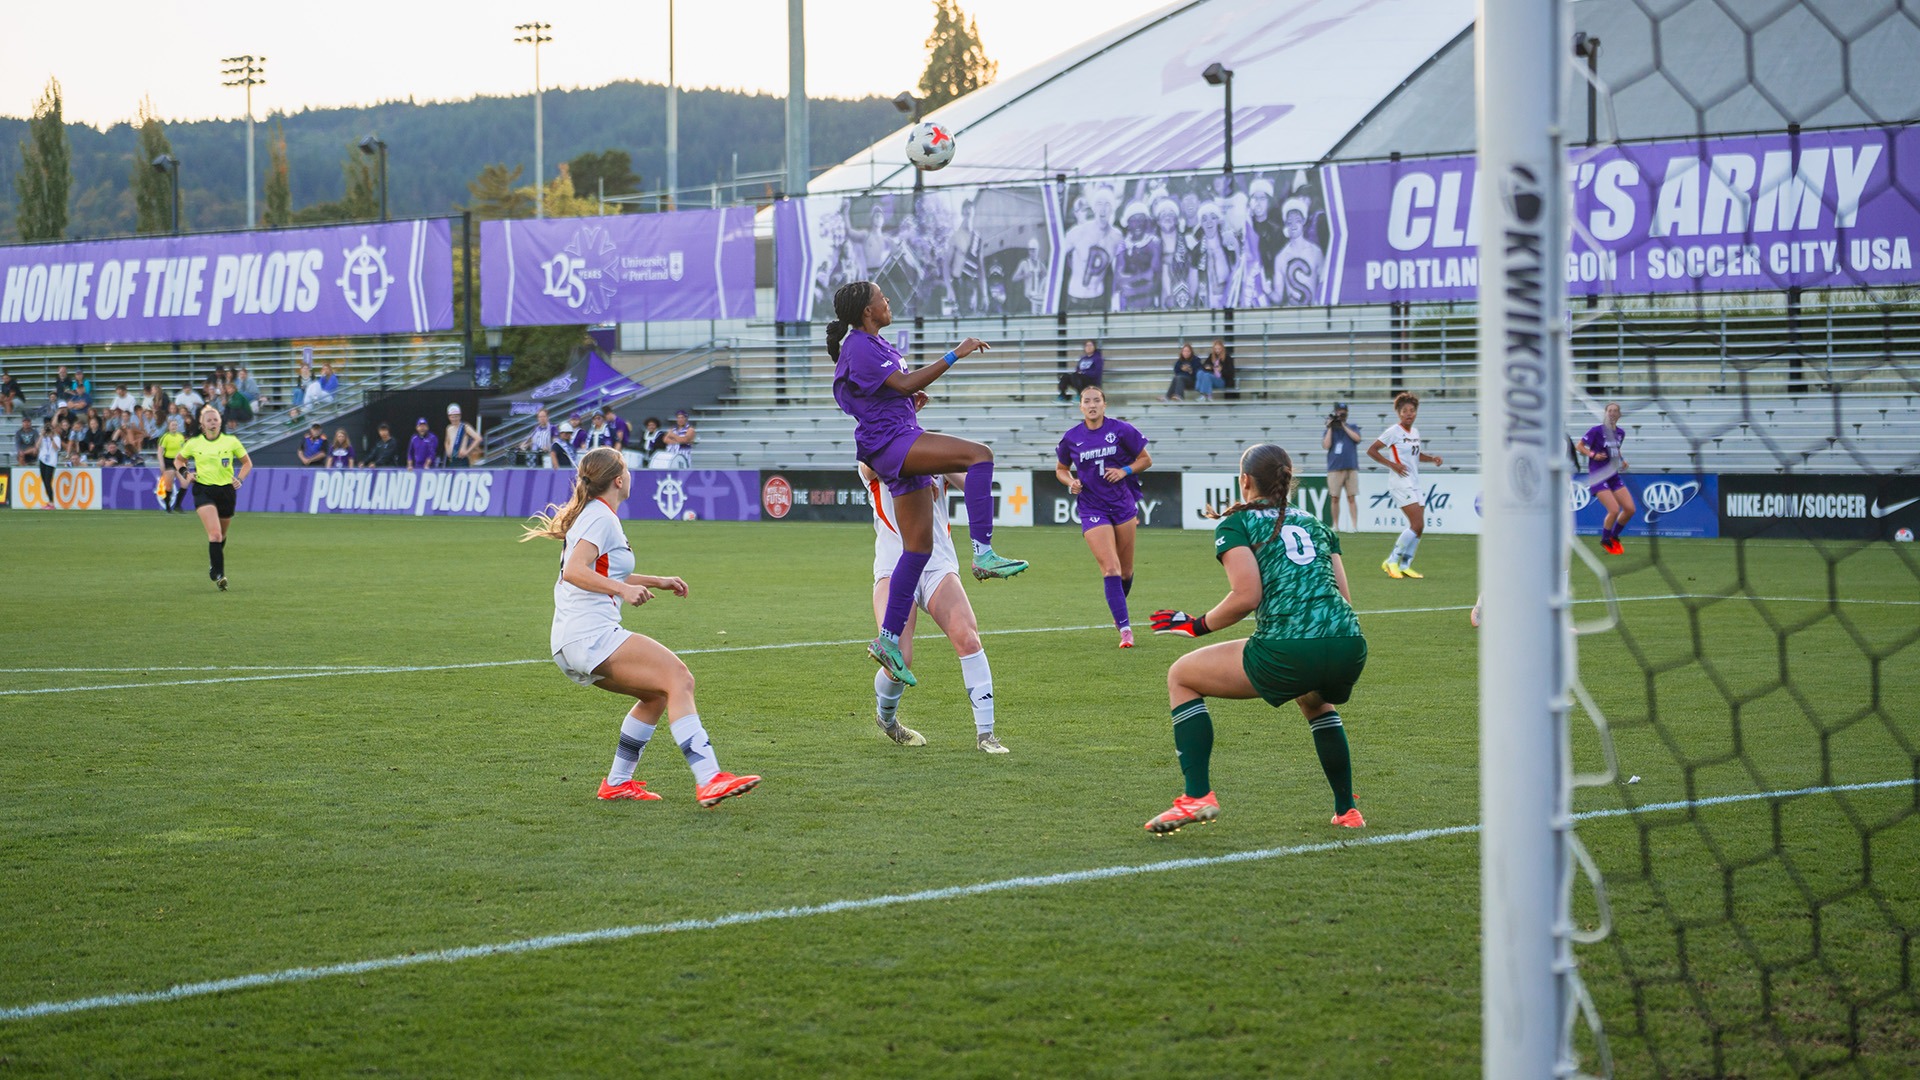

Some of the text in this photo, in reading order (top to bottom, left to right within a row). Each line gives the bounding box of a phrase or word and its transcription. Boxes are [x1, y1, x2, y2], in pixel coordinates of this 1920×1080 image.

[1387, 144, 1883, 252] CL'S ARMY
[621, 256, 669, 269] University
[1647, 245, 1761, 280] SOCCER
[1769, 239, 1842, 275] CITY,
[1851, 236, 1912, 270] USA
[1, 248, 324, 327] HOME OF THE PILOTS
[541, 253, 603, 309] 125 YEARS
[629, 269, 670, 282] Portland
[1080, 446, 1117, 462] PORTLAND
[1095, 460, 1105, 476] 7
[310, 471, 417, 514] PORTLAND
[415, 471, 494, 516] PILOTS
[793, 490, 866, 505] THE HEART OF THE
[1645, 482, 1682, 512] AAA
[1726, 493, 1867, 519] NIKE.COM/SOCCER
[1375, 518, 1442, 527] AIRLES
[1281, 525, 1316, 565] 0
